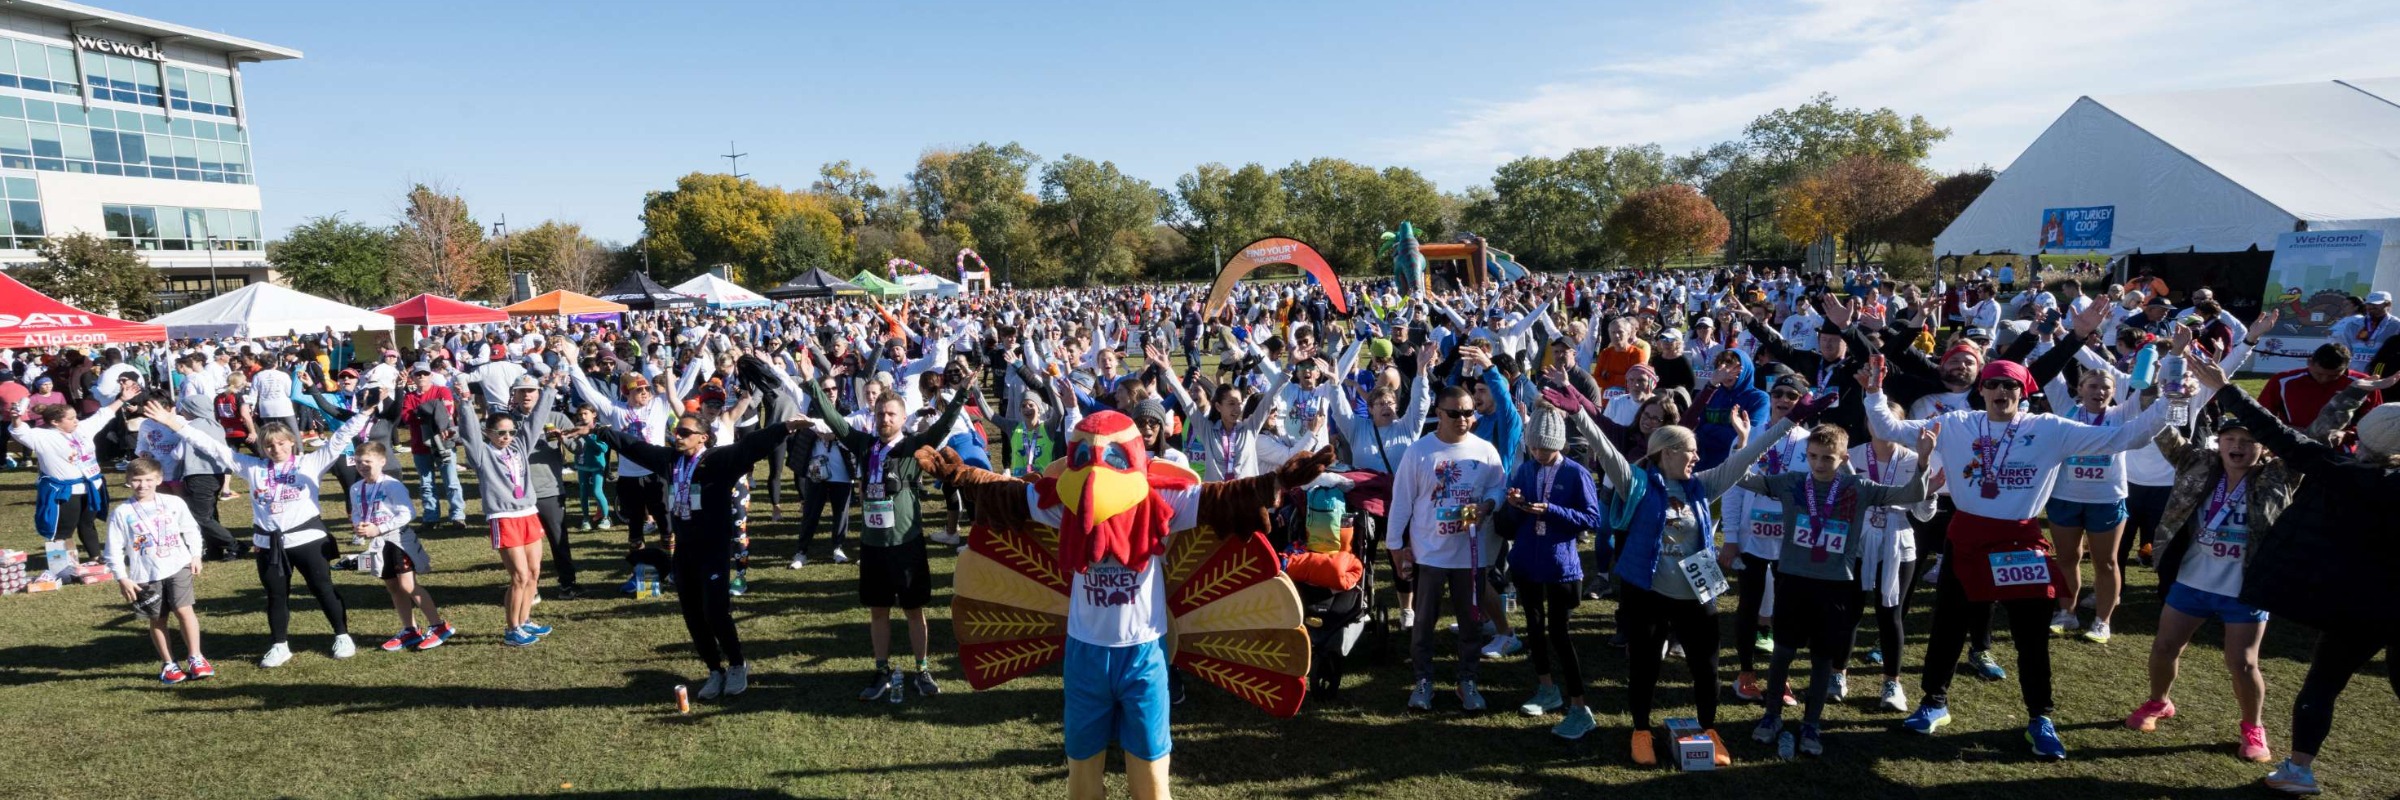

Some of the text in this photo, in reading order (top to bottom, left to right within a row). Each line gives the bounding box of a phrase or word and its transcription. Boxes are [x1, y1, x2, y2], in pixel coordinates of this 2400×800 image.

[76, 34, 167, 62] wework
[2066, 208, 2112, 220] VIP TURKEY
[2075, 221, 2098, 232] COOP
[2295, 234, 2363, 244] Welcome!
[1246, 243, 1298, 257] FIND YOUR Y
[21, 313, 93, 326] ATI
[24, 333, 107, 347] ATIpt.com
[1999, 468, 2038, 477] URKEY
[2074, 467, 2104, 479] 942
[1999, 477, 2032, 485] TROT
[869, 514, 883, 526] 45
[1753, 522, 1783, 537] 308
[2213, 542, 2241, 558] 94
[1084, 573, 1138, 587] TURKEY
[1686, 562, 1711, 594] 9191
[1997, 565, 2047, 583] 3082
